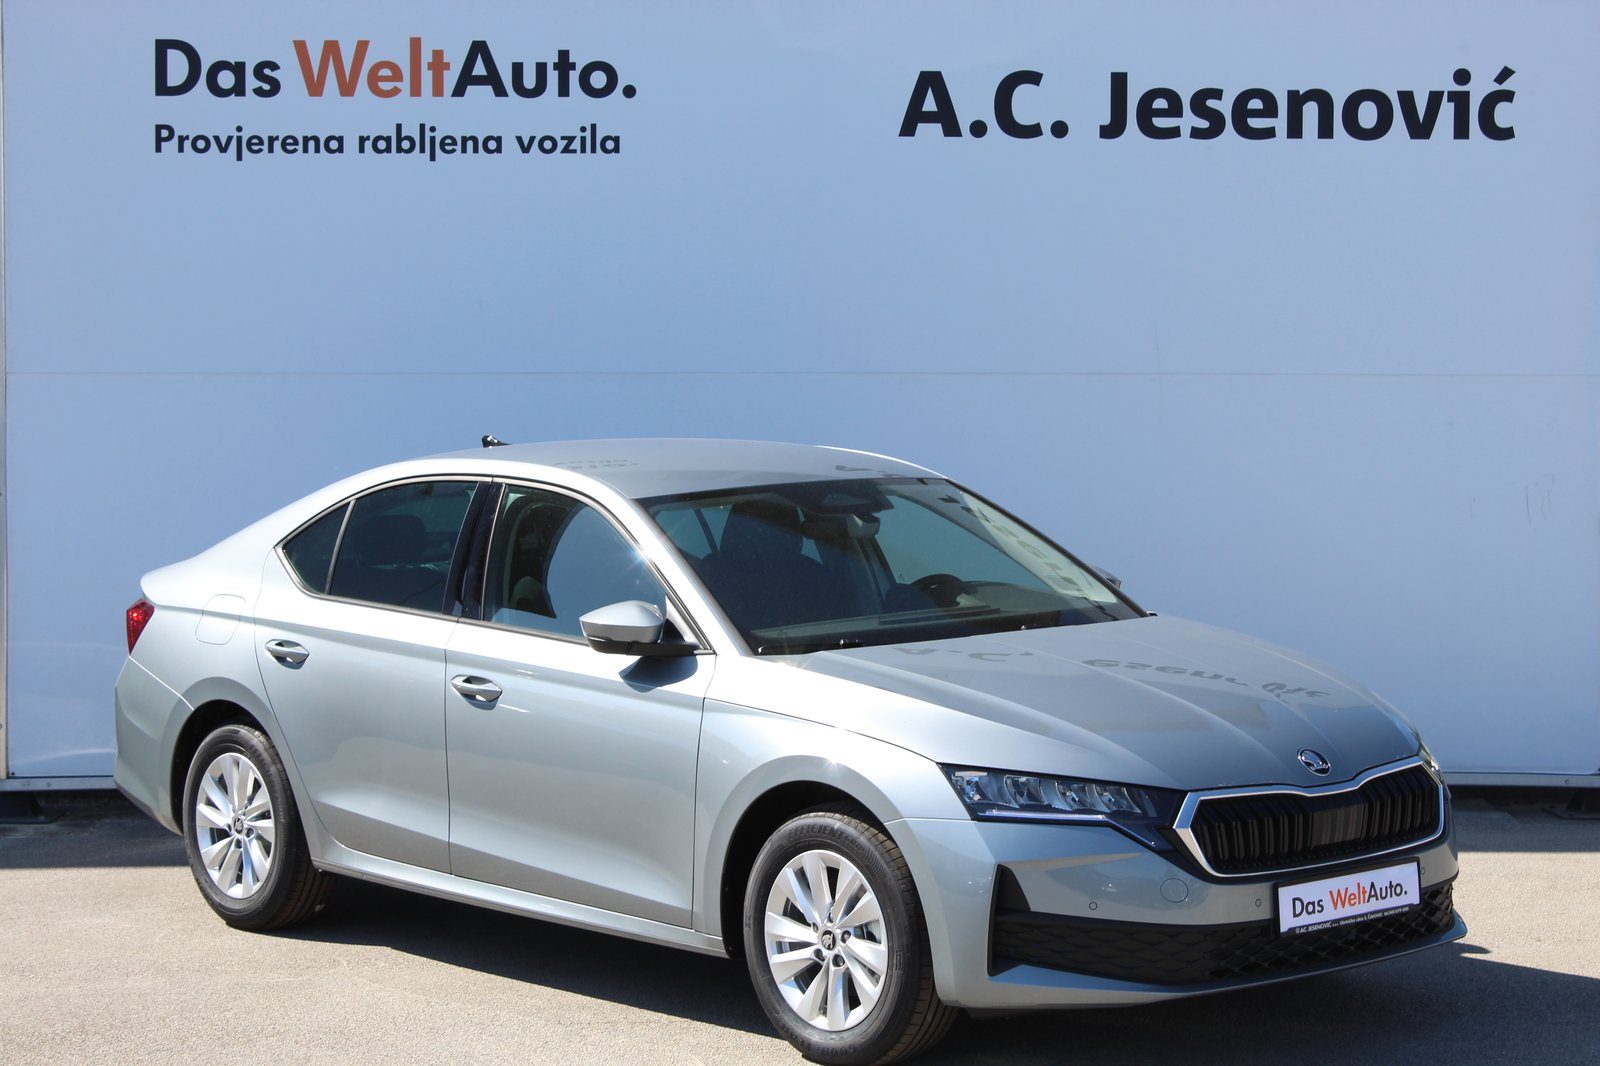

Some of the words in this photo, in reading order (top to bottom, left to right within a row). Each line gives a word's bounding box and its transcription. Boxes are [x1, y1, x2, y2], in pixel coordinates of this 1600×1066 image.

[155, 38, 281, 98] Das
[293, 37, 637, 98] WeltAuto.
[898, 69, 1069, 139] A.C.
[1099, 65, 1516, 141] Jesenović
[155, 124, 345, 162] Provjerena
[358, 123, 503, 162] rabljena
[515, 123, 621, 154] vozila
[1292, 897, 1325, 918] Das
[1329, 880, 1408, 910] WeltAuto.
